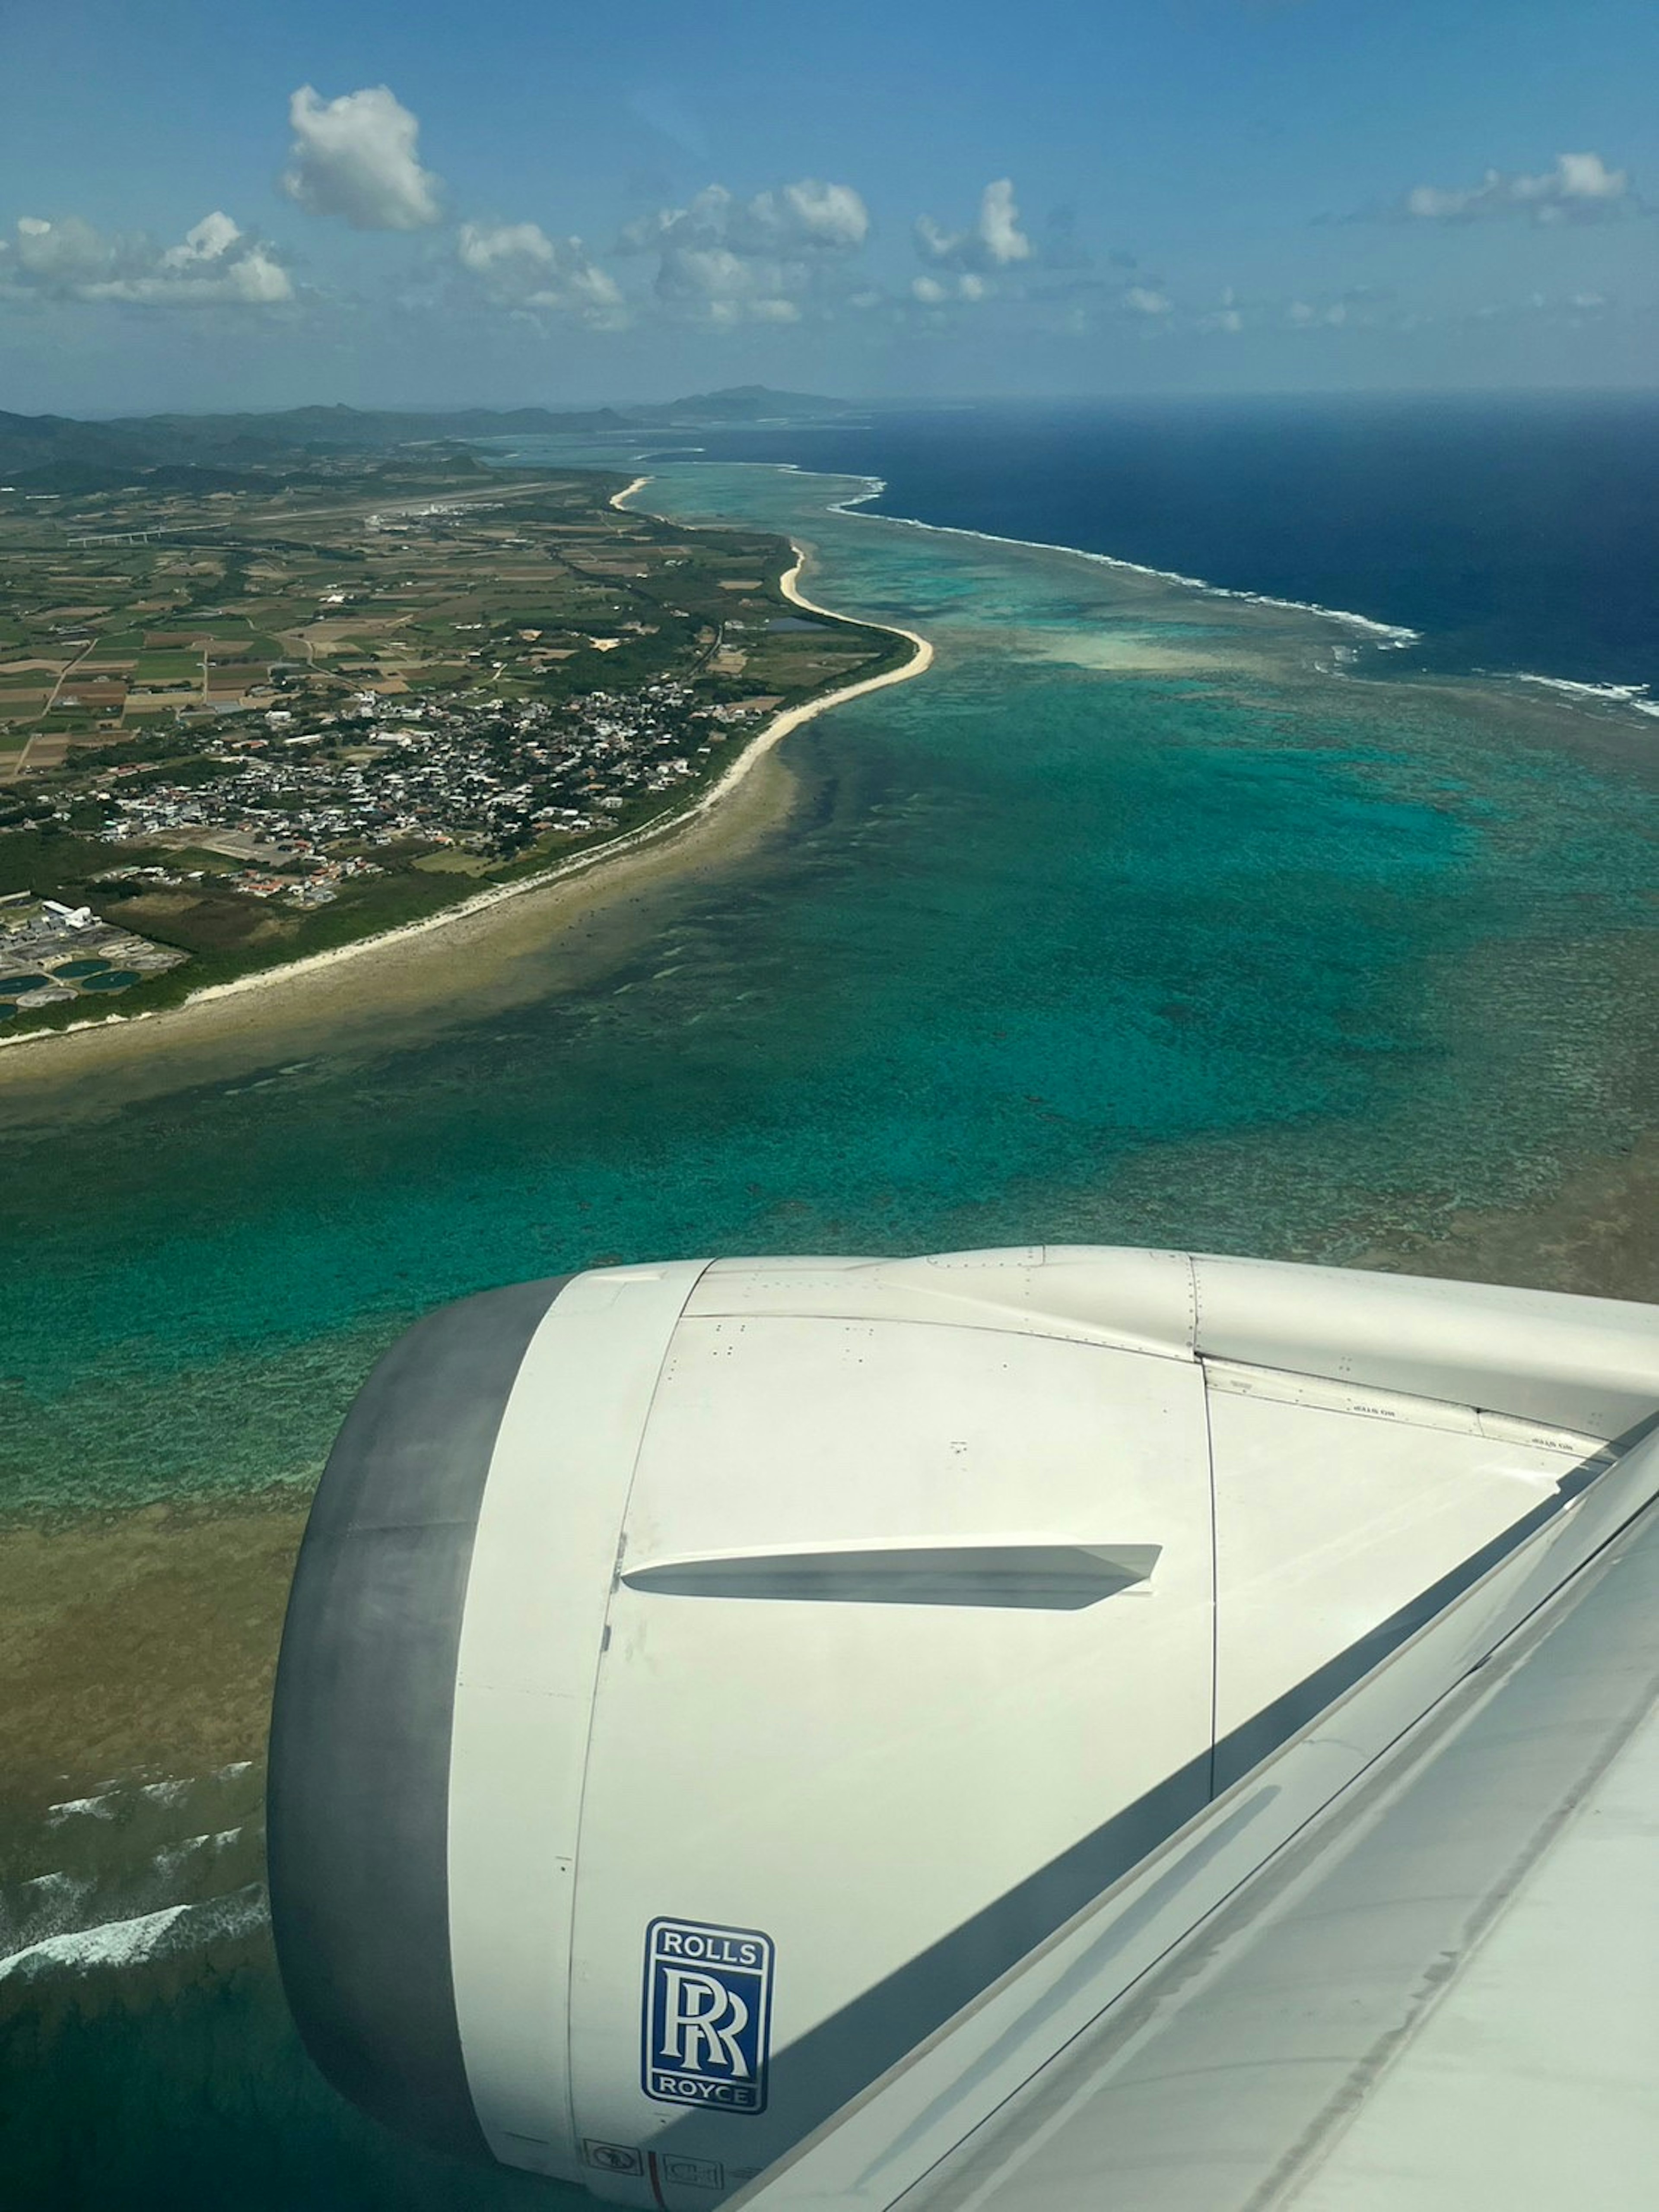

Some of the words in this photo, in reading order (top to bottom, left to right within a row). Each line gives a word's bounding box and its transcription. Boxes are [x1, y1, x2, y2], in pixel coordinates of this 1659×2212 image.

[664, 1932, 756, 1964] ROLLS
[659, 1968, 749, 2078] RR
[659, 2077, 748, 2104] ROYCE
